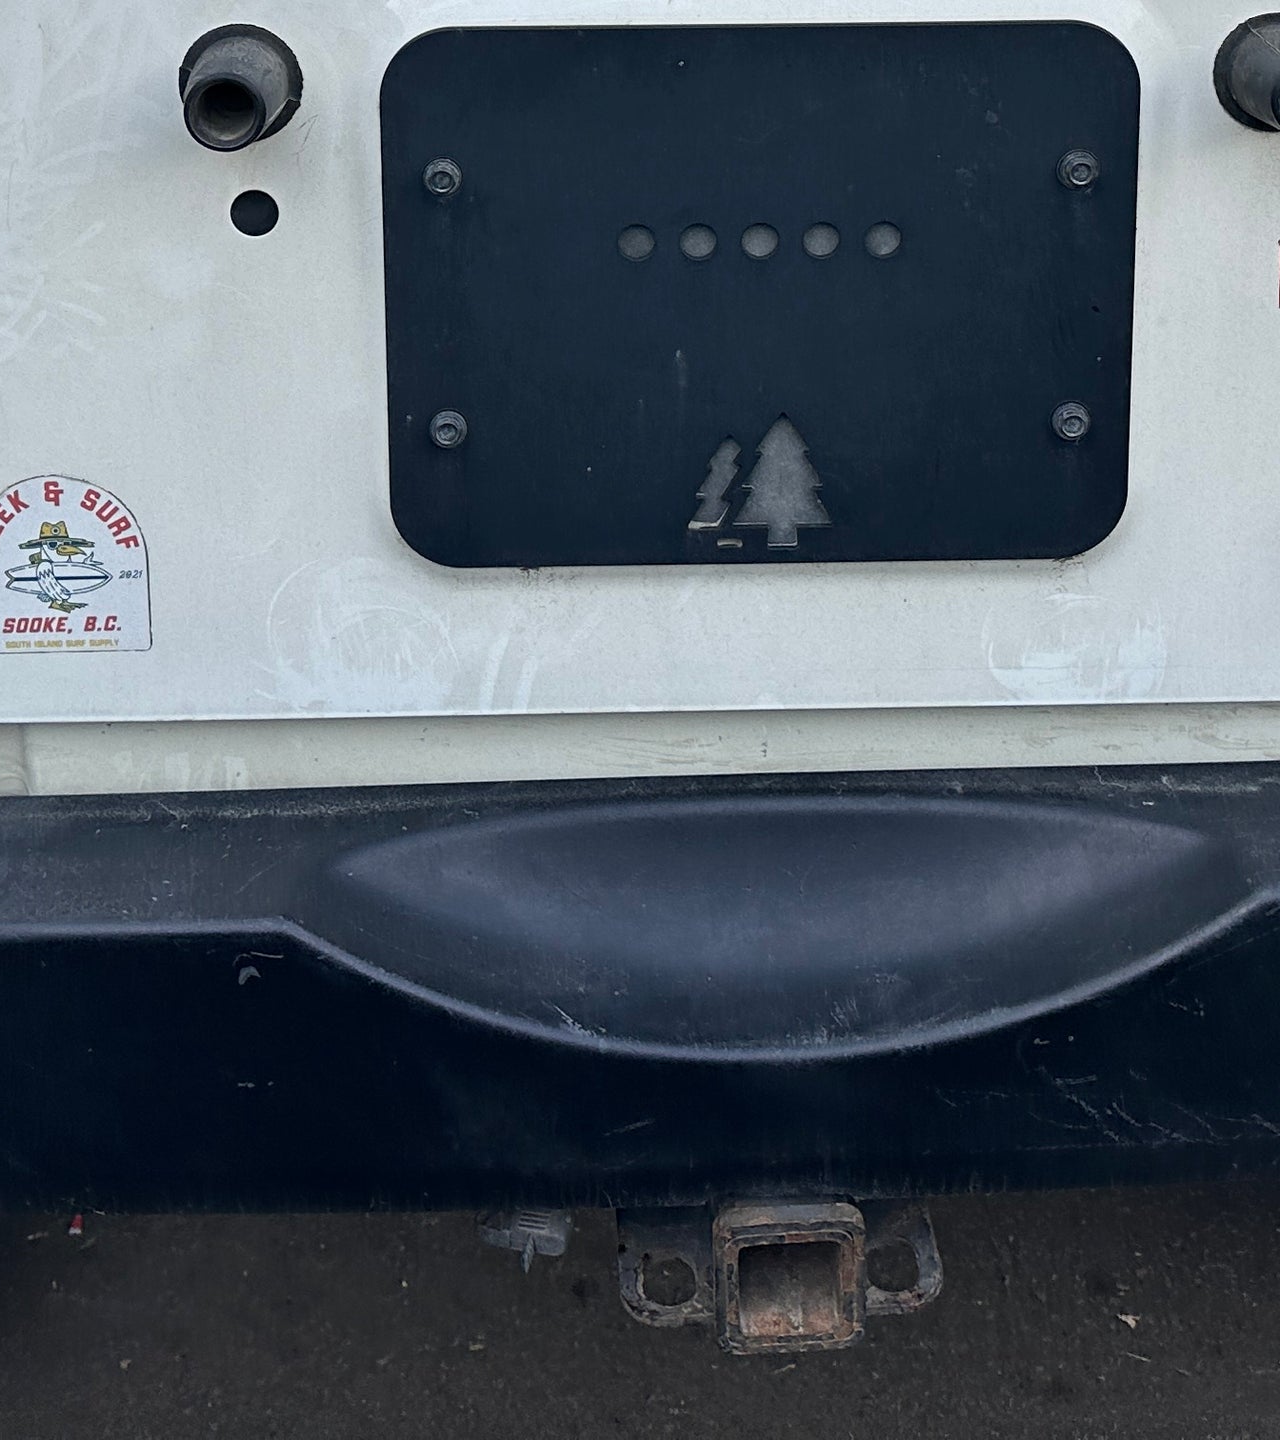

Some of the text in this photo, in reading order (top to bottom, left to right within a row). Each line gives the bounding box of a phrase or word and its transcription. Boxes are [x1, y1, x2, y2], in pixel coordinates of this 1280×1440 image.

[44, 481, 64, 506] &
[80, 488, 140, 549] SURF
[119, 570, 143, 579] 2021
[2, 615, 122, 634] SOOKE, B.C.
[5, 641, 31, 649] SOUTH
